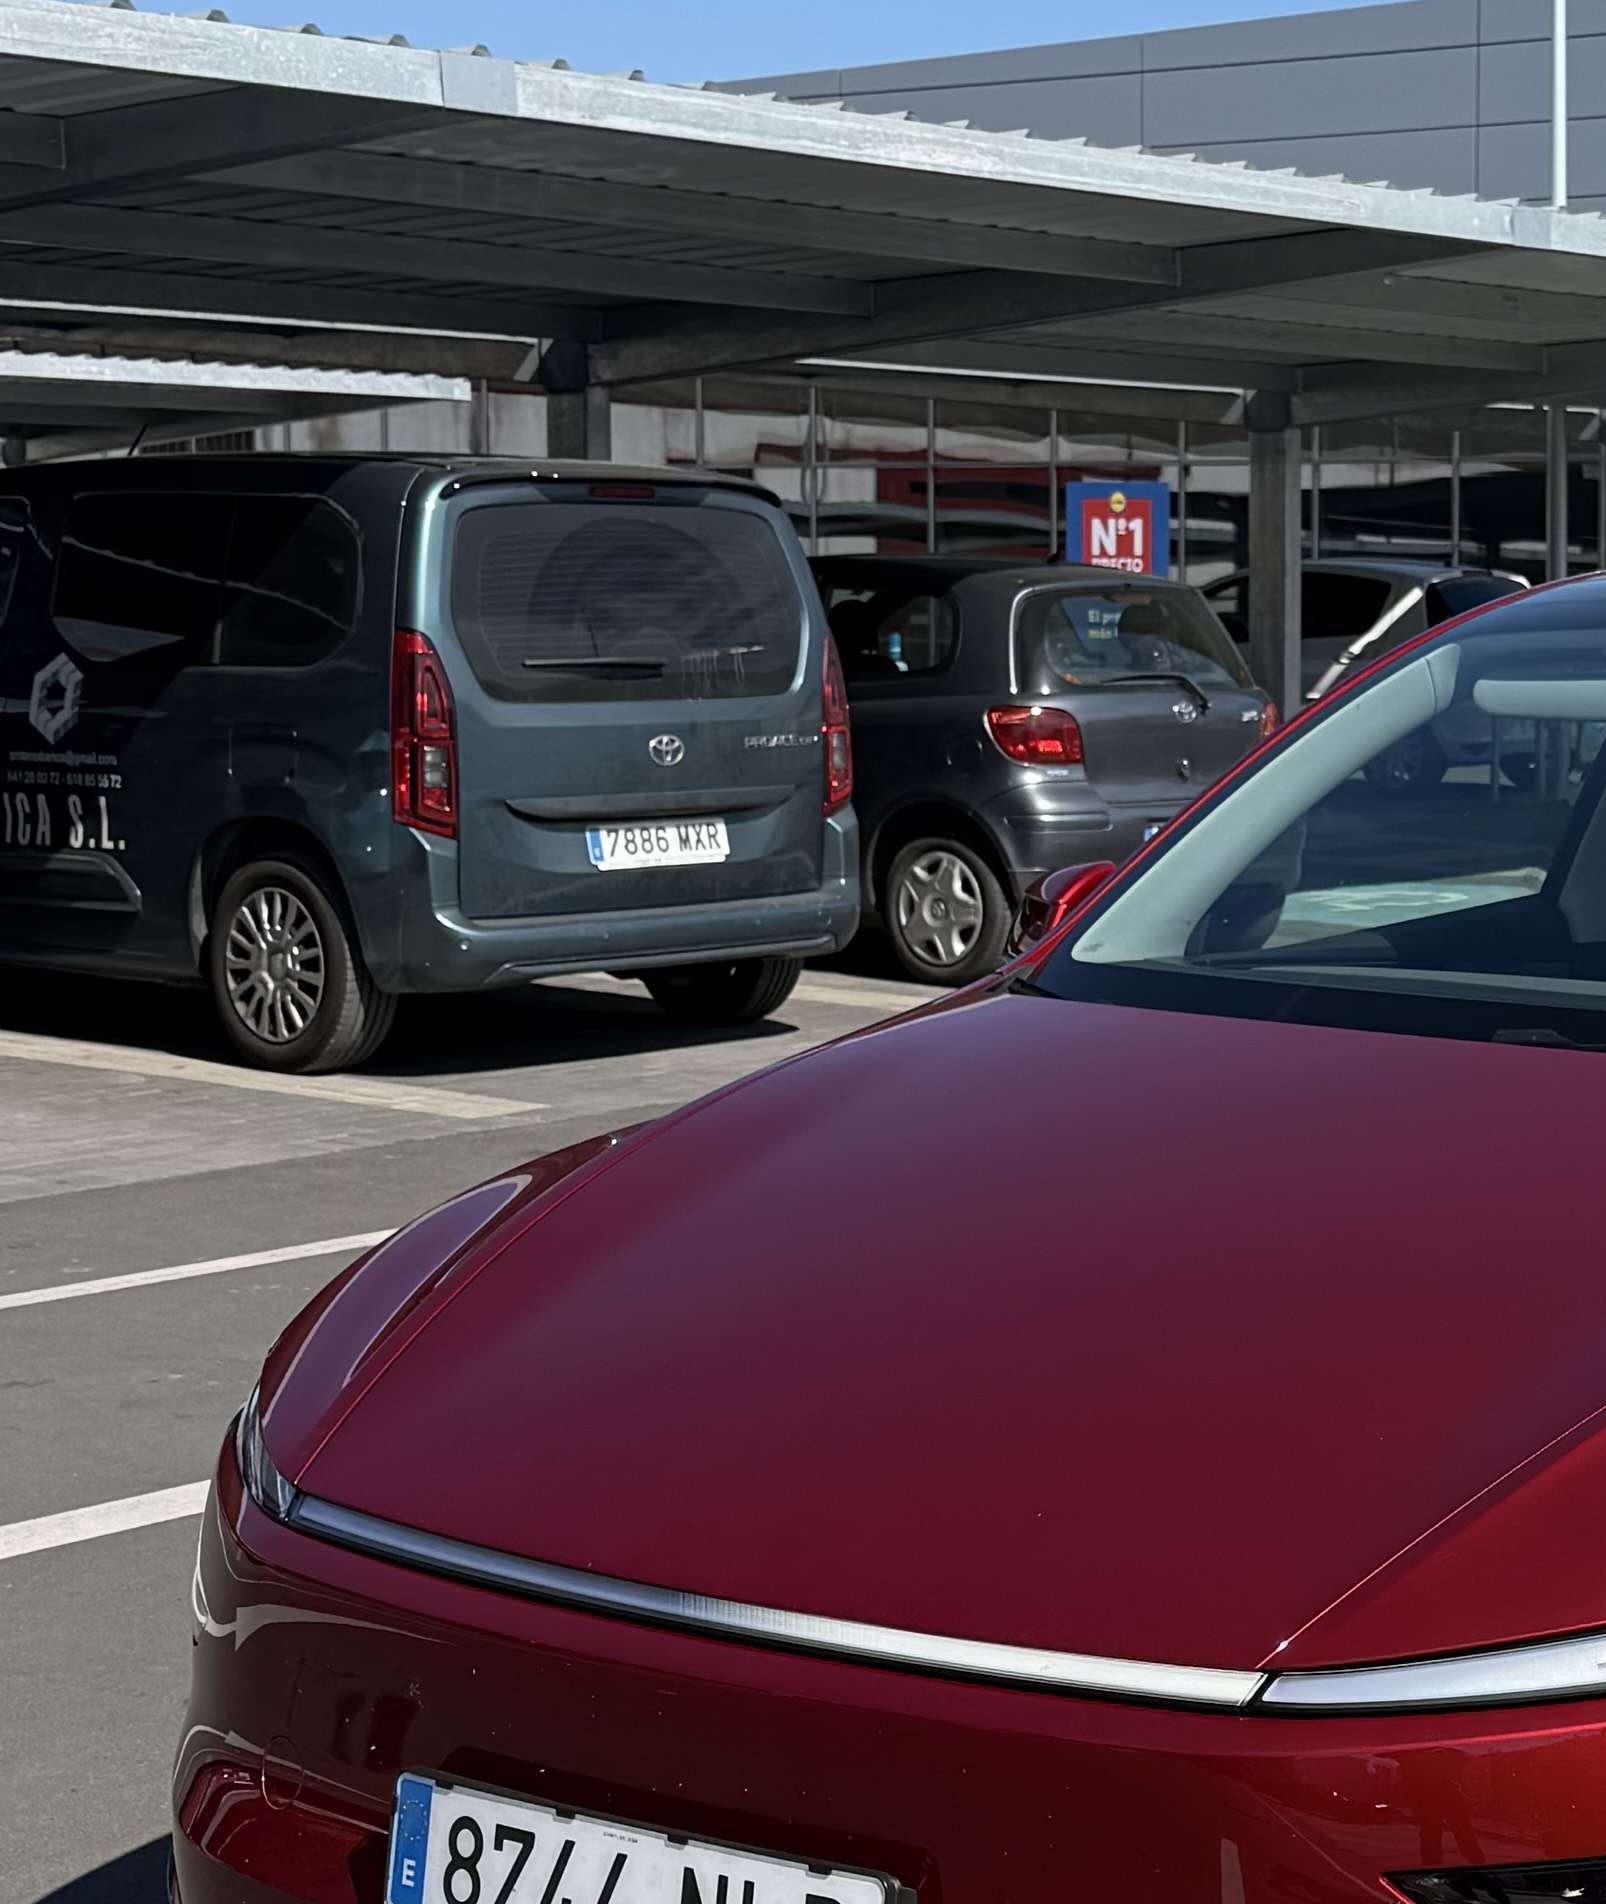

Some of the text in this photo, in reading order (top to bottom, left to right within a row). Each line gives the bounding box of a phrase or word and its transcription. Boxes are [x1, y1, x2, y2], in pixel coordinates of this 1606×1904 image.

[110, 773, 122, 789] 72
[67, 794, 125, 850] S.L.
[607, 827, 669, 857] 7886
[677, 823, 721, 851] MXR
[401, 1858, 416, 1887] E
